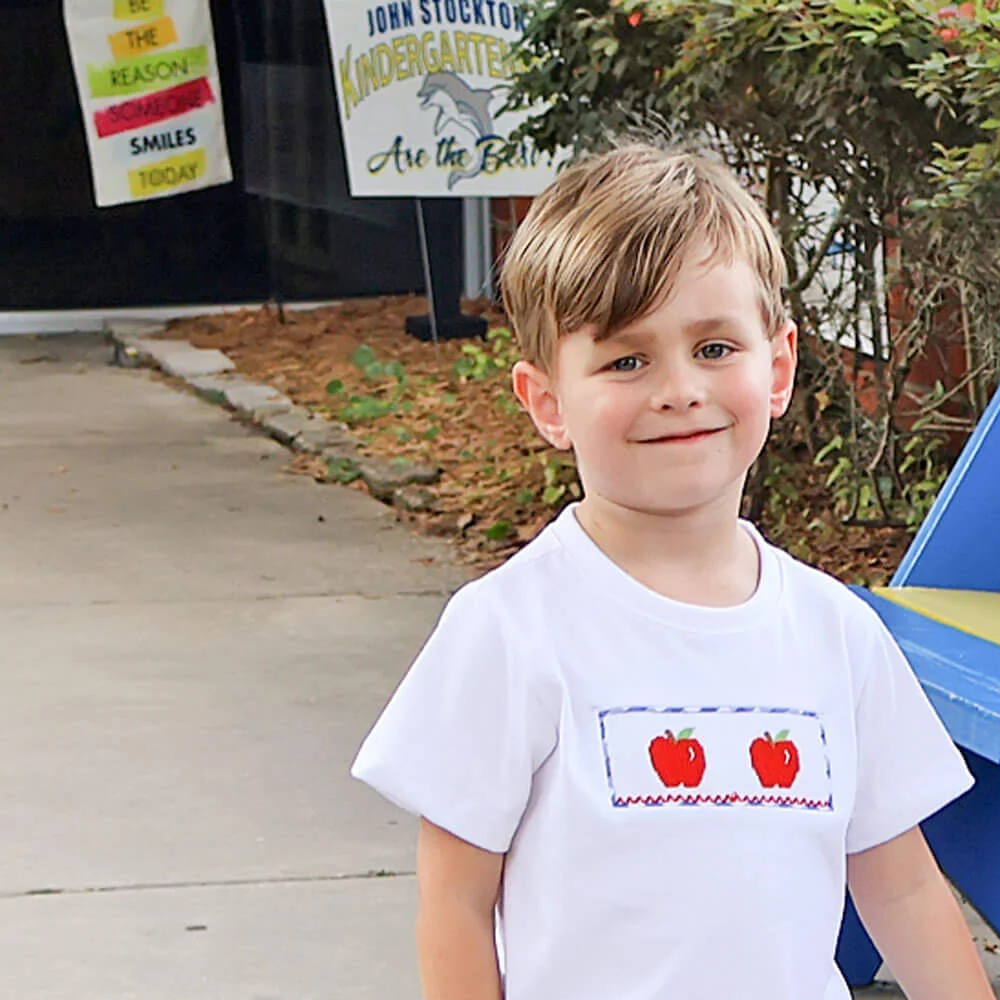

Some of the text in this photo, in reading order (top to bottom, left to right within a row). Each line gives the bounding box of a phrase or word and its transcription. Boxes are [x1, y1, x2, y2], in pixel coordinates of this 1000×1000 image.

[367, 0, 414, 37] JOHN
[125, 27, 158, 49] THE
[110, 57, 189, 87] REASON
[108, 91, 202, 122] SOMEONE
[130, 128, 197, 156] SMILES
[367, 135, 431, 175] Are
[436, 135, 472, 168] the
[138, 161, 198, 190] TODAY
